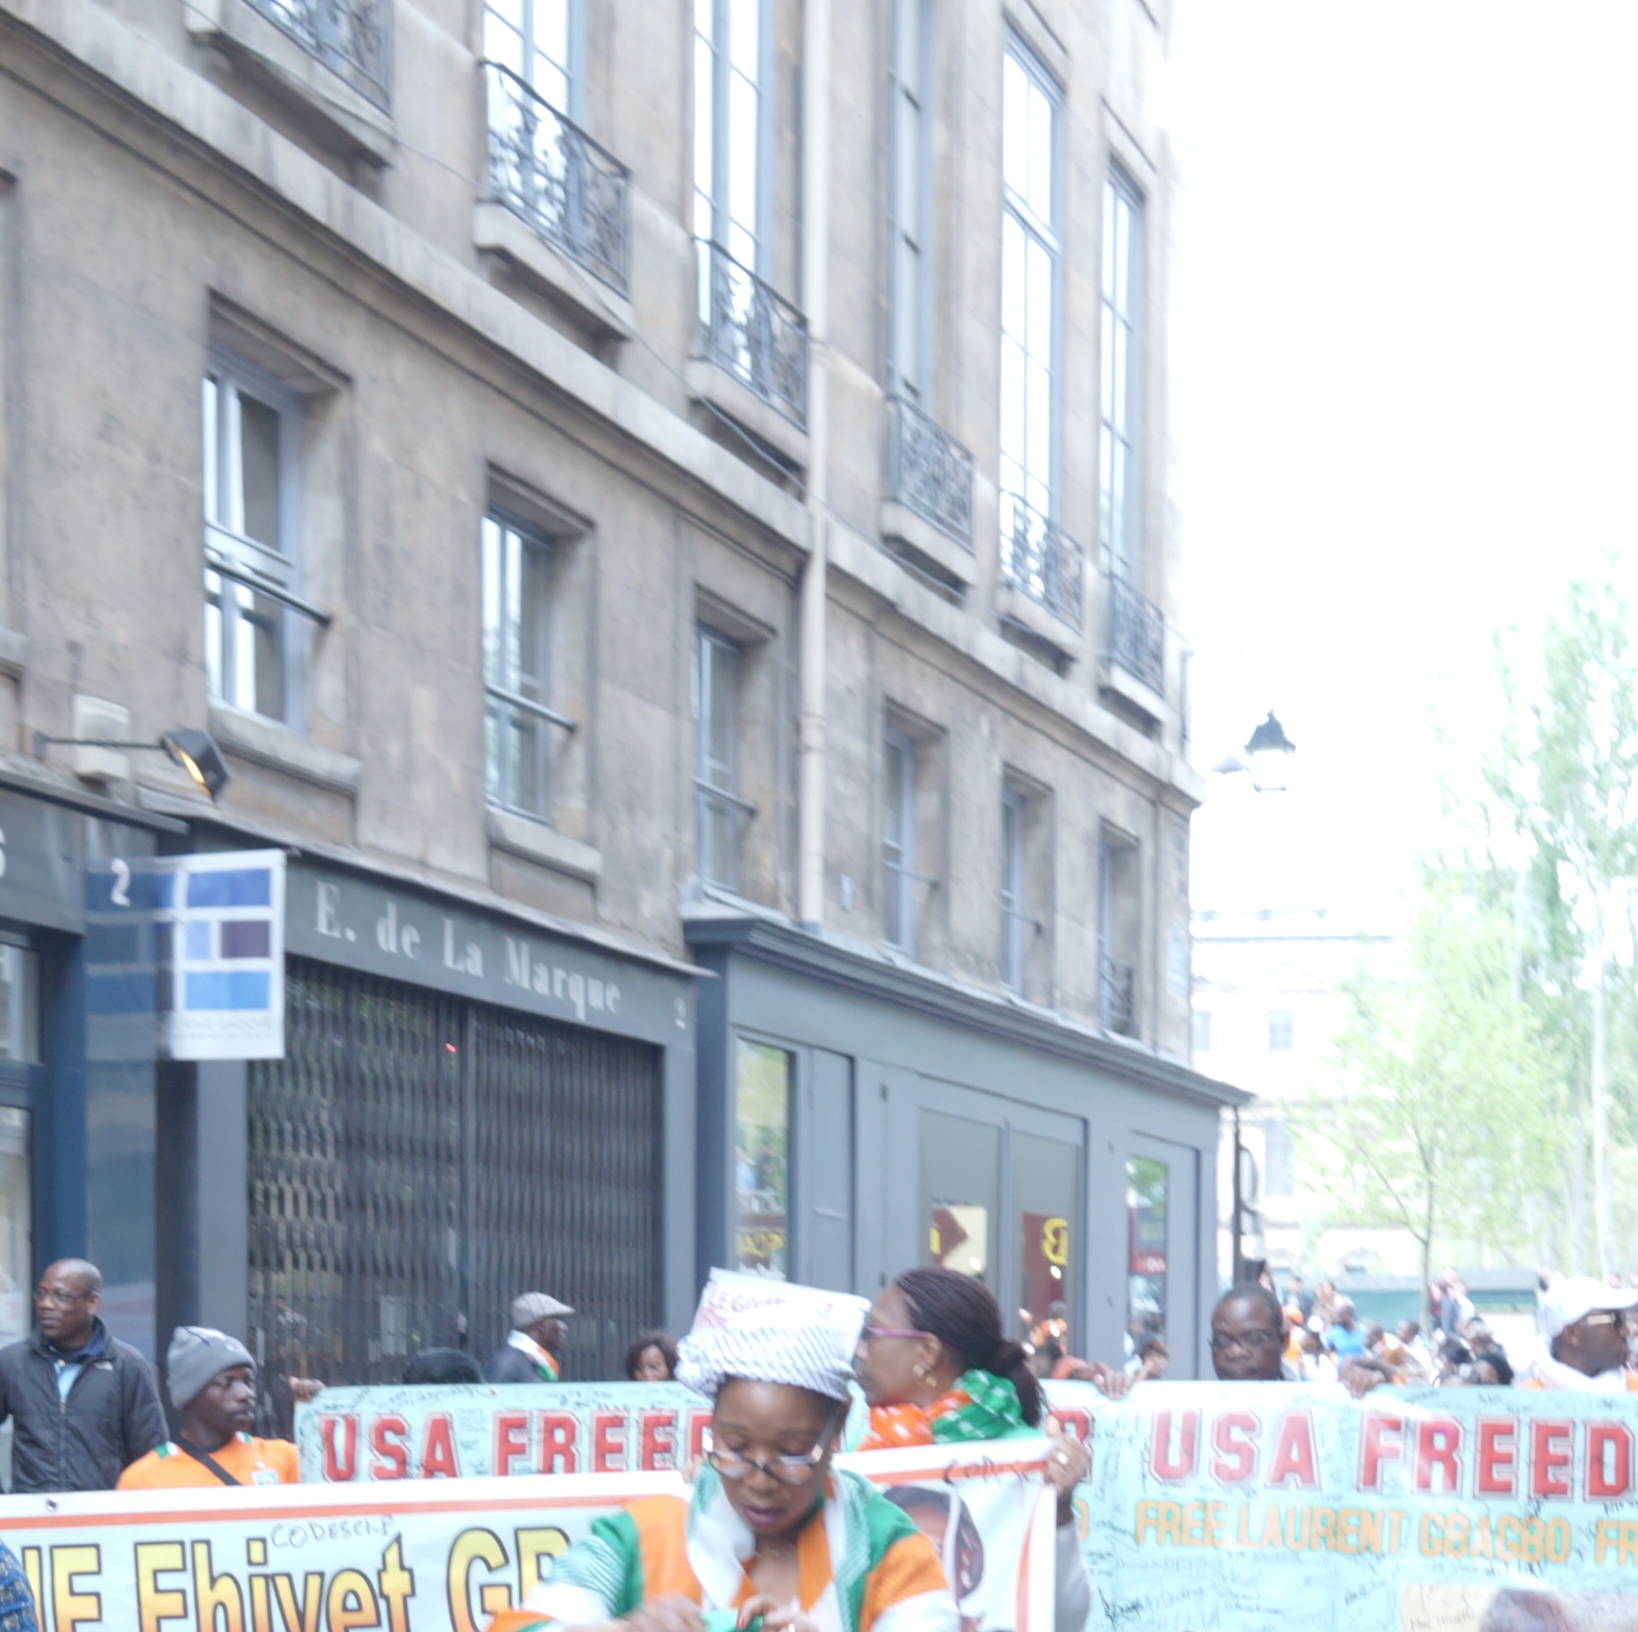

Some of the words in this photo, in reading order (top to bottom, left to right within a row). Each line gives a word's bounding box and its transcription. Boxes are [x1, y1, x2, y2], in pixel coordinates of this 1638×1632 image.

[110, 857, 132, 908] 2
[316, 880, 357, 943] E.
[376, 895, 422, 962] de
[442, 916, 486, 981] La
[503, 940, 623, 1023] Marque
[318, 1412, 461, 1483] USA
[1148, 1406, 1323, 1492] USA
[1135, 1499, 1226, 1547] FREE
[1238, 1502, 1407, 1555] LAURENT
[1420, 1510, 1572, 1565] GBAGBO
